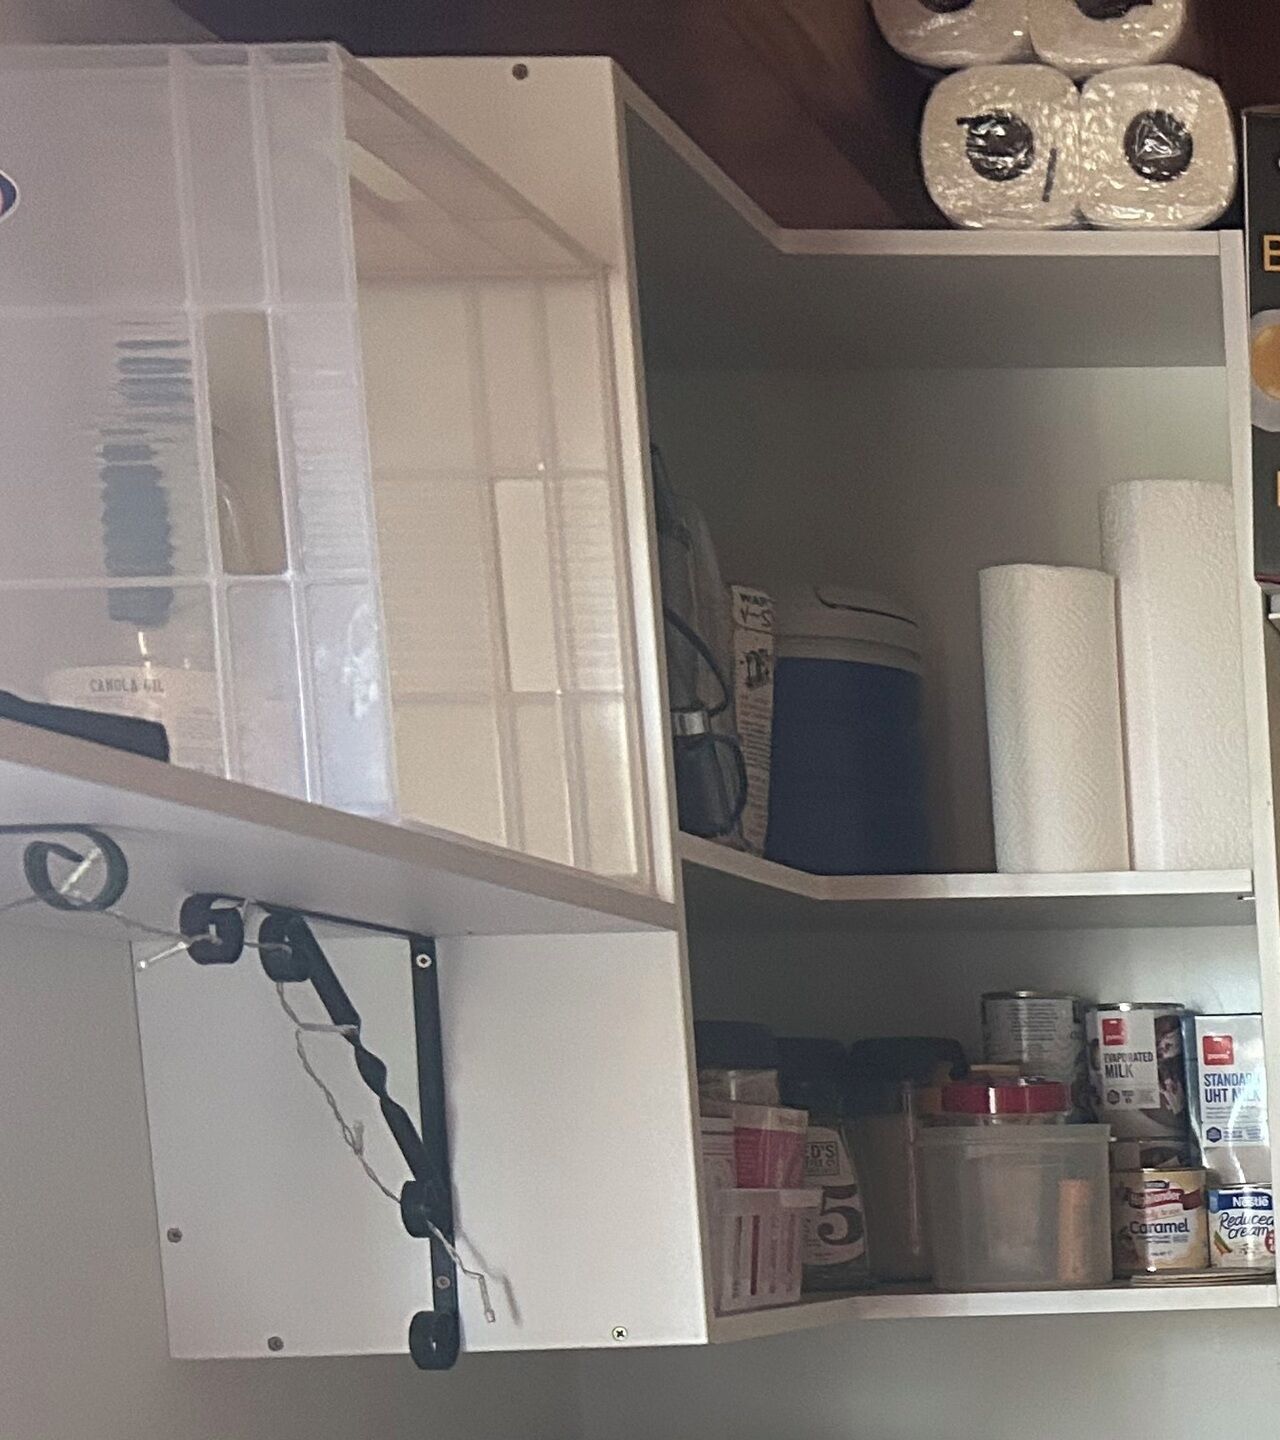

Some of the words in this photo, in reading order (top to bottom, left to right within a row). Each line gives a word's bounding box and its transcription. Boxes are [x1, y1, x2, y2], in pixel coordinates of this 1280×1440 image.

[89, 678, 138, 693] CANOLA
[1104, 1063, 1135, 1079] MILK
[1204, 1088, 1229, 1104] UHT
[817, 1184, 865, 1246] 5
[1129, 1217, 1191, 1235] Caramel
[1227, 1226, 1269, 1240] cream
